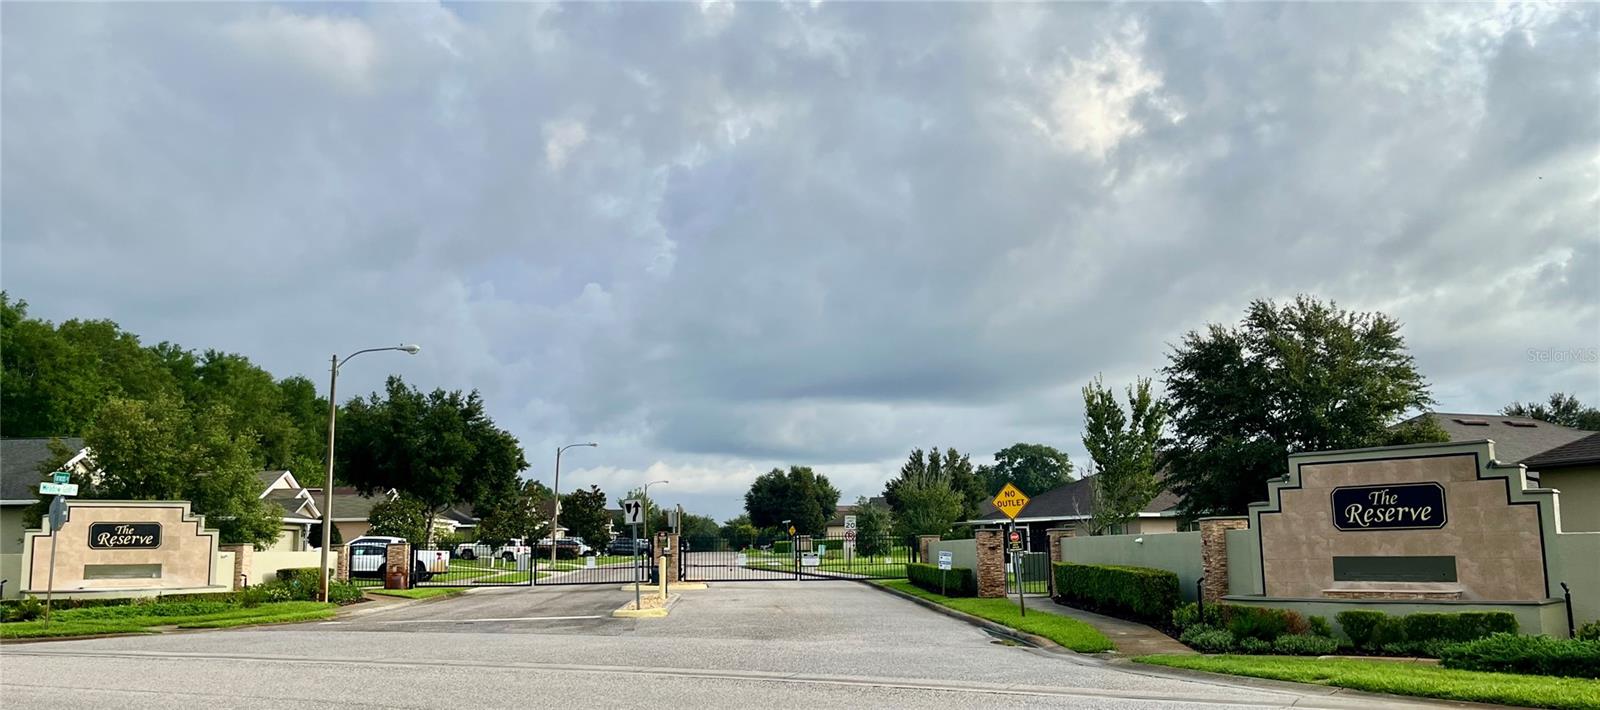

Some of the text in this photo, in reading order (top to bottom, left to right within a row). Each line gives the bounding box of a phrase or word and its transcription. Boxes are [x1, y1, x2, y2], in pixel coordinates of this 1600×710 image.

[997, 499, 1024, 507] OUTLET
[1368, 489, 1398, 505] The
[1345, 503, 1432, 527] Reserve
[115, 524, 135, 535] The
[97, 532, 154, 547] Reserve
